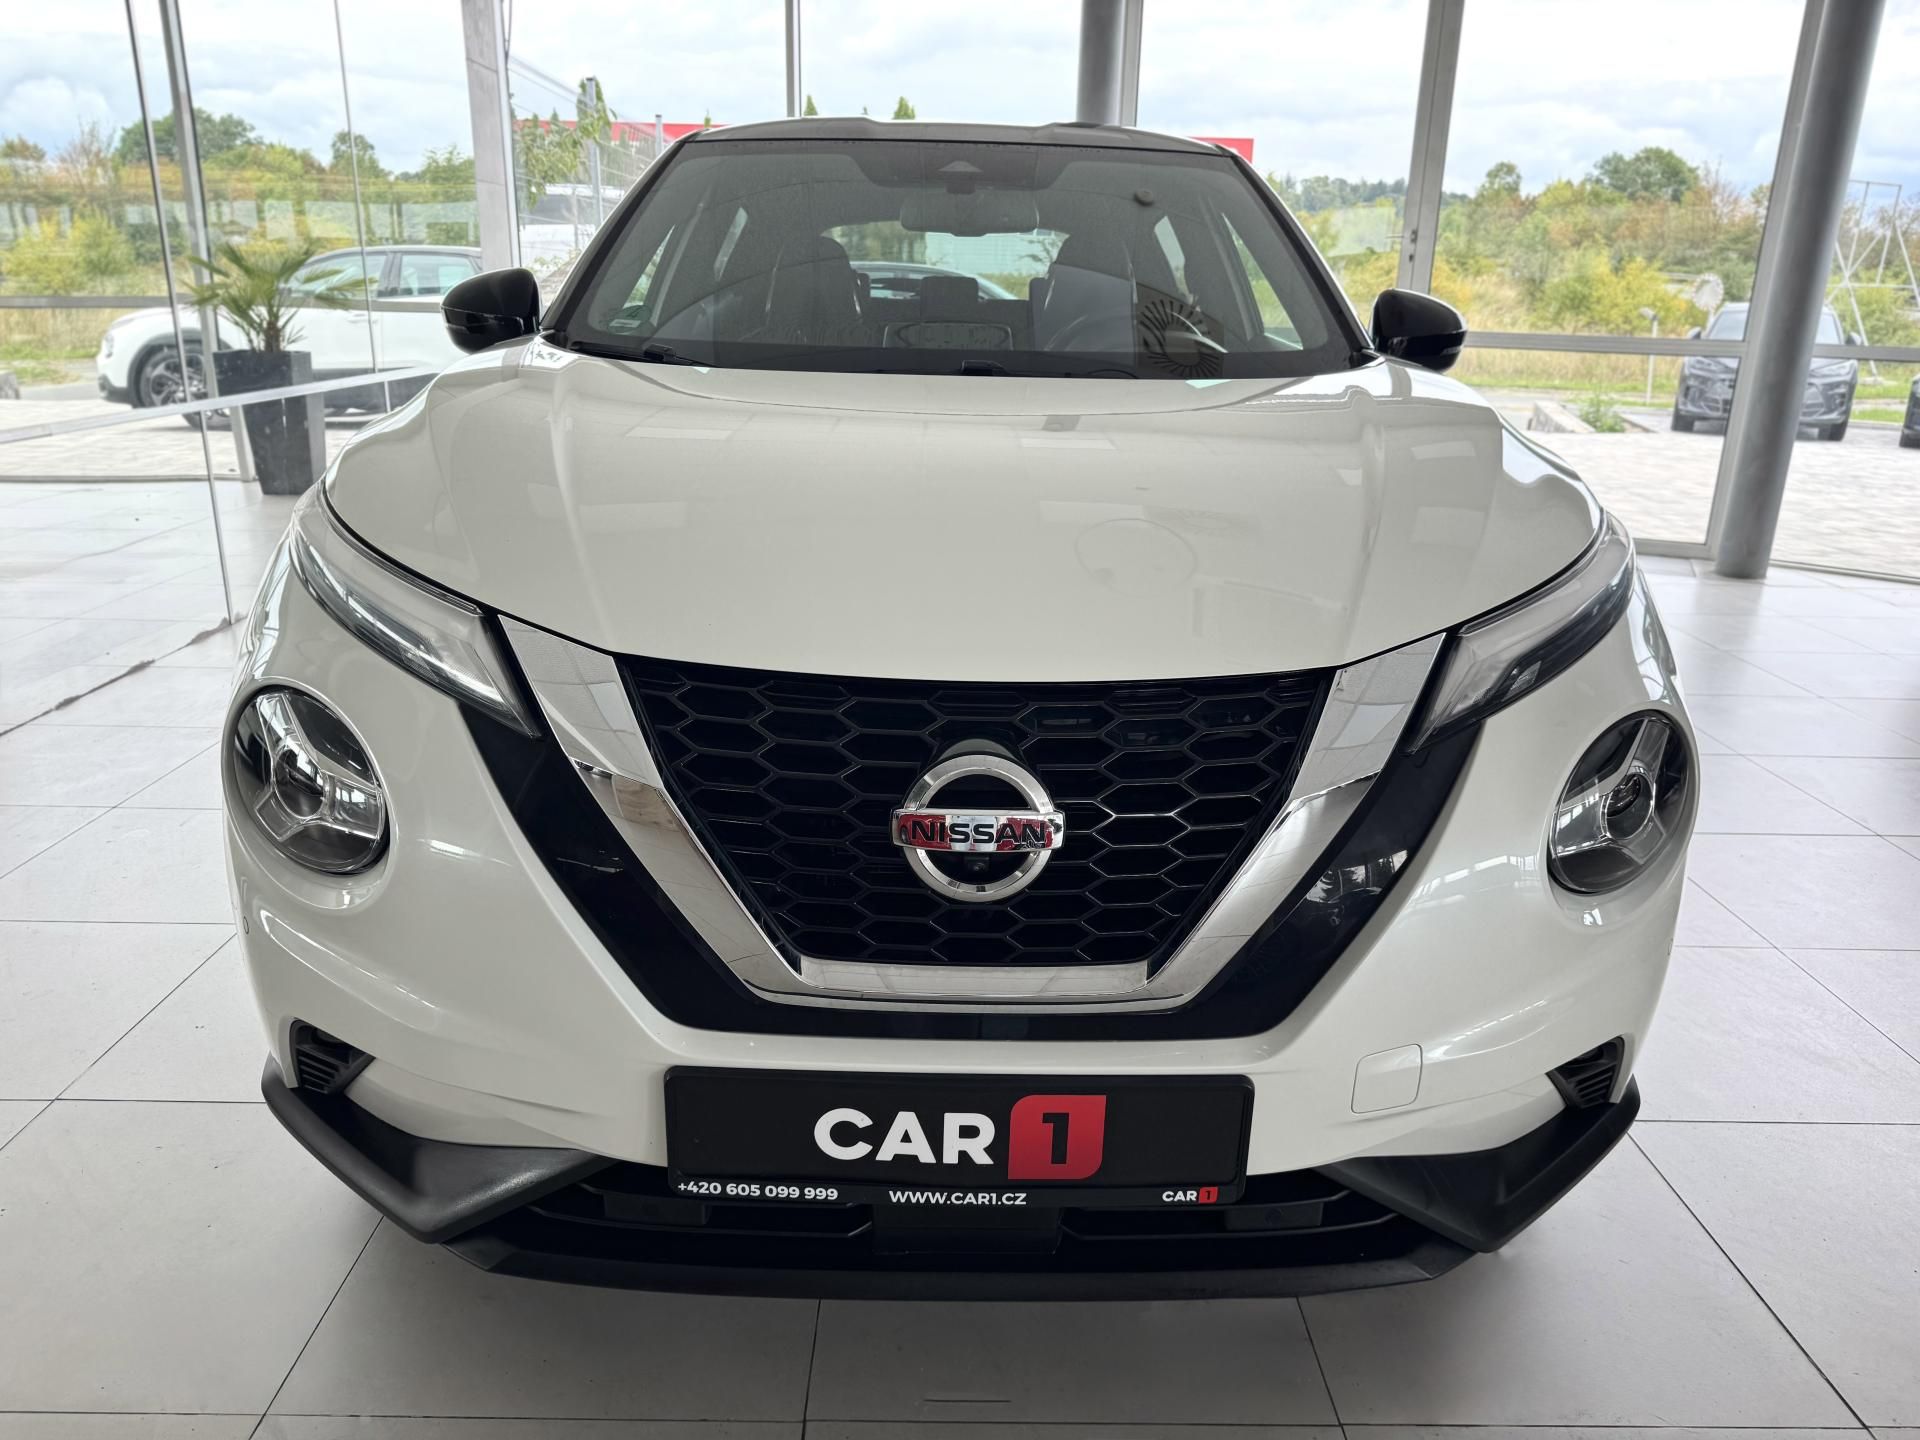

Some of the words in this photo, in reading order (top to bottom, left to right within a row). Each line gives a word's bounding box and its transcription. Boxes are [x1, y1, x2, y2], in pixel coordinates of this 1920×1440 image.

[911, 820, 1046, 845] NISSAN
[813, 1107, 995, 1165] CAR
[1041, 1112, 1070, 1165] 1
[678, 1181, 722, 1195] +420
[726, 1183, 761, 1196] 605
[765, 1185, 800, 1199] 099
[804, 1187, 839, 1200] 999
[888, 1190, 1027, 1205] WWW.CAR1.CZ
[1162, 1190, 1198, 1202] CAR
